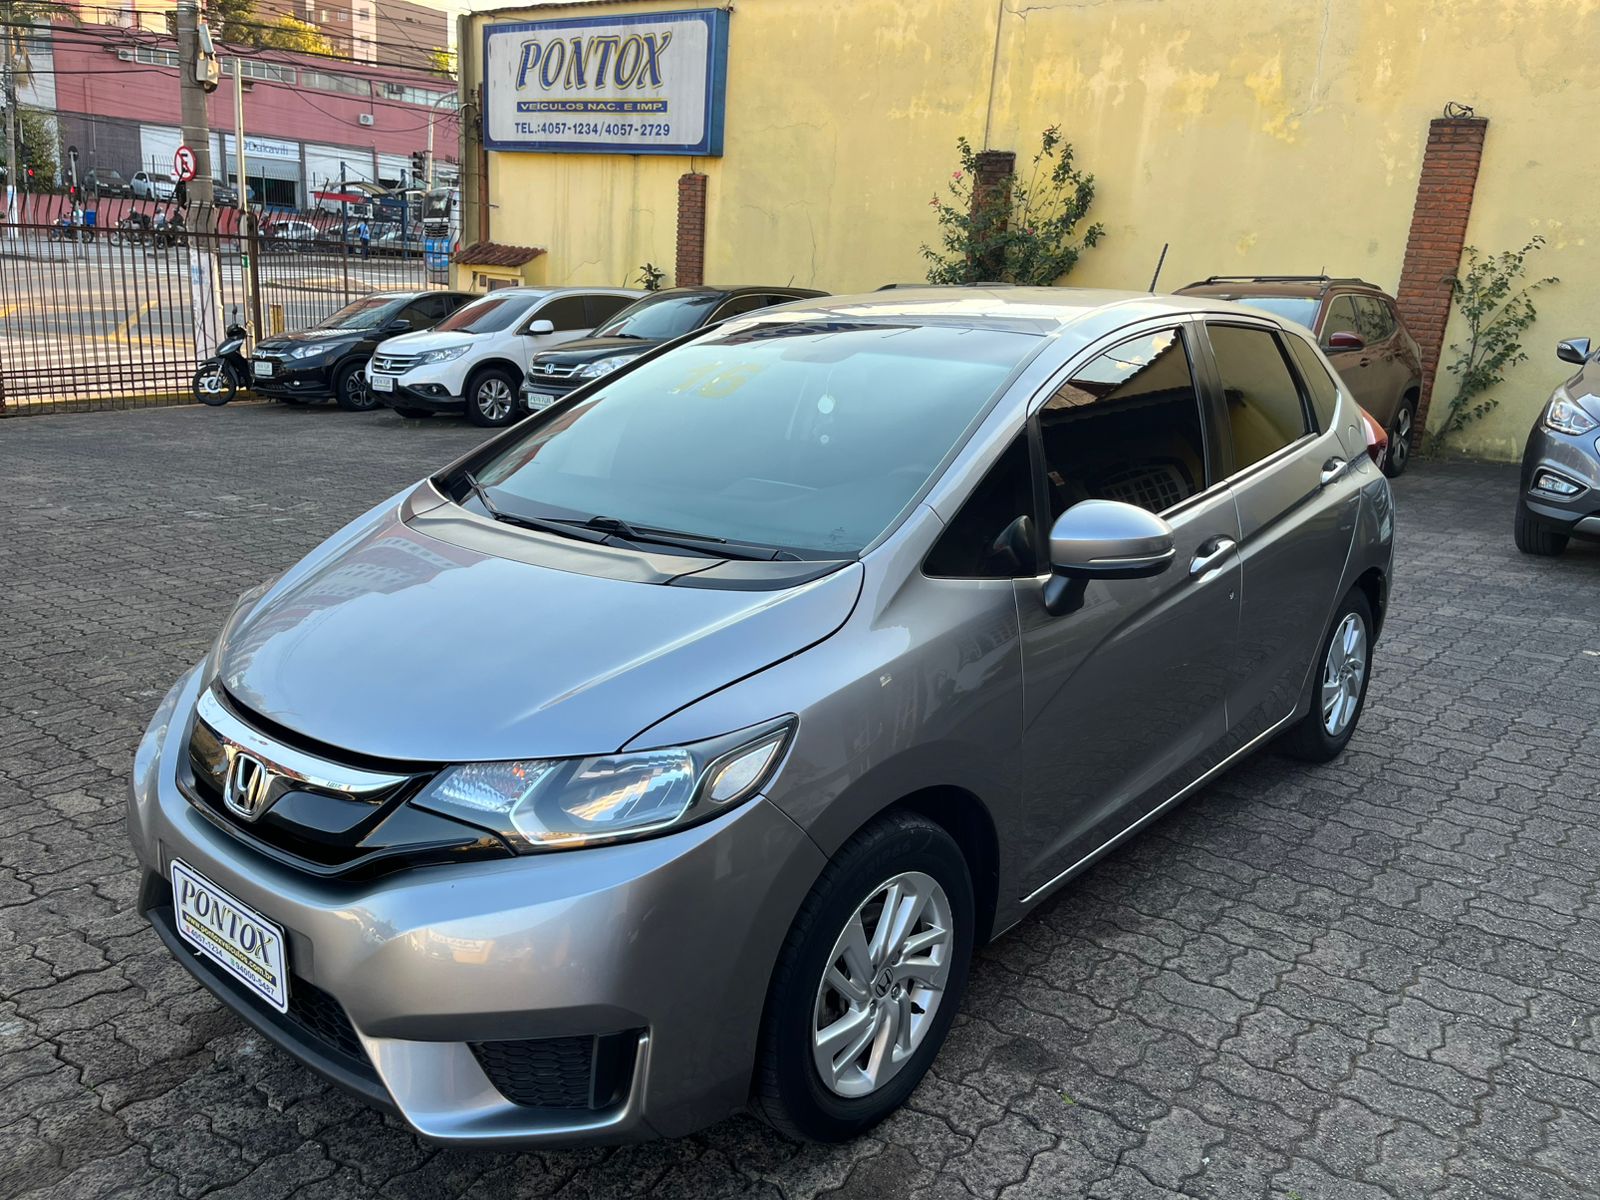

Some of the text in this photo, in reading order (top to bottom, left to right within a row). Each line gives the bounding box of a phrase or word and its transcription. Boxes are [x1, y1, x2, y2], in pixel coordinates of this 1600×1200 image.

[515, 31, 672, 91] PONTOX
[588, 103, 620, 111] NAC.
[624, 103, 633, 111] E
[637, 103, 664, 111] IMP.
[181, 876, 273, 969] PONTOX
